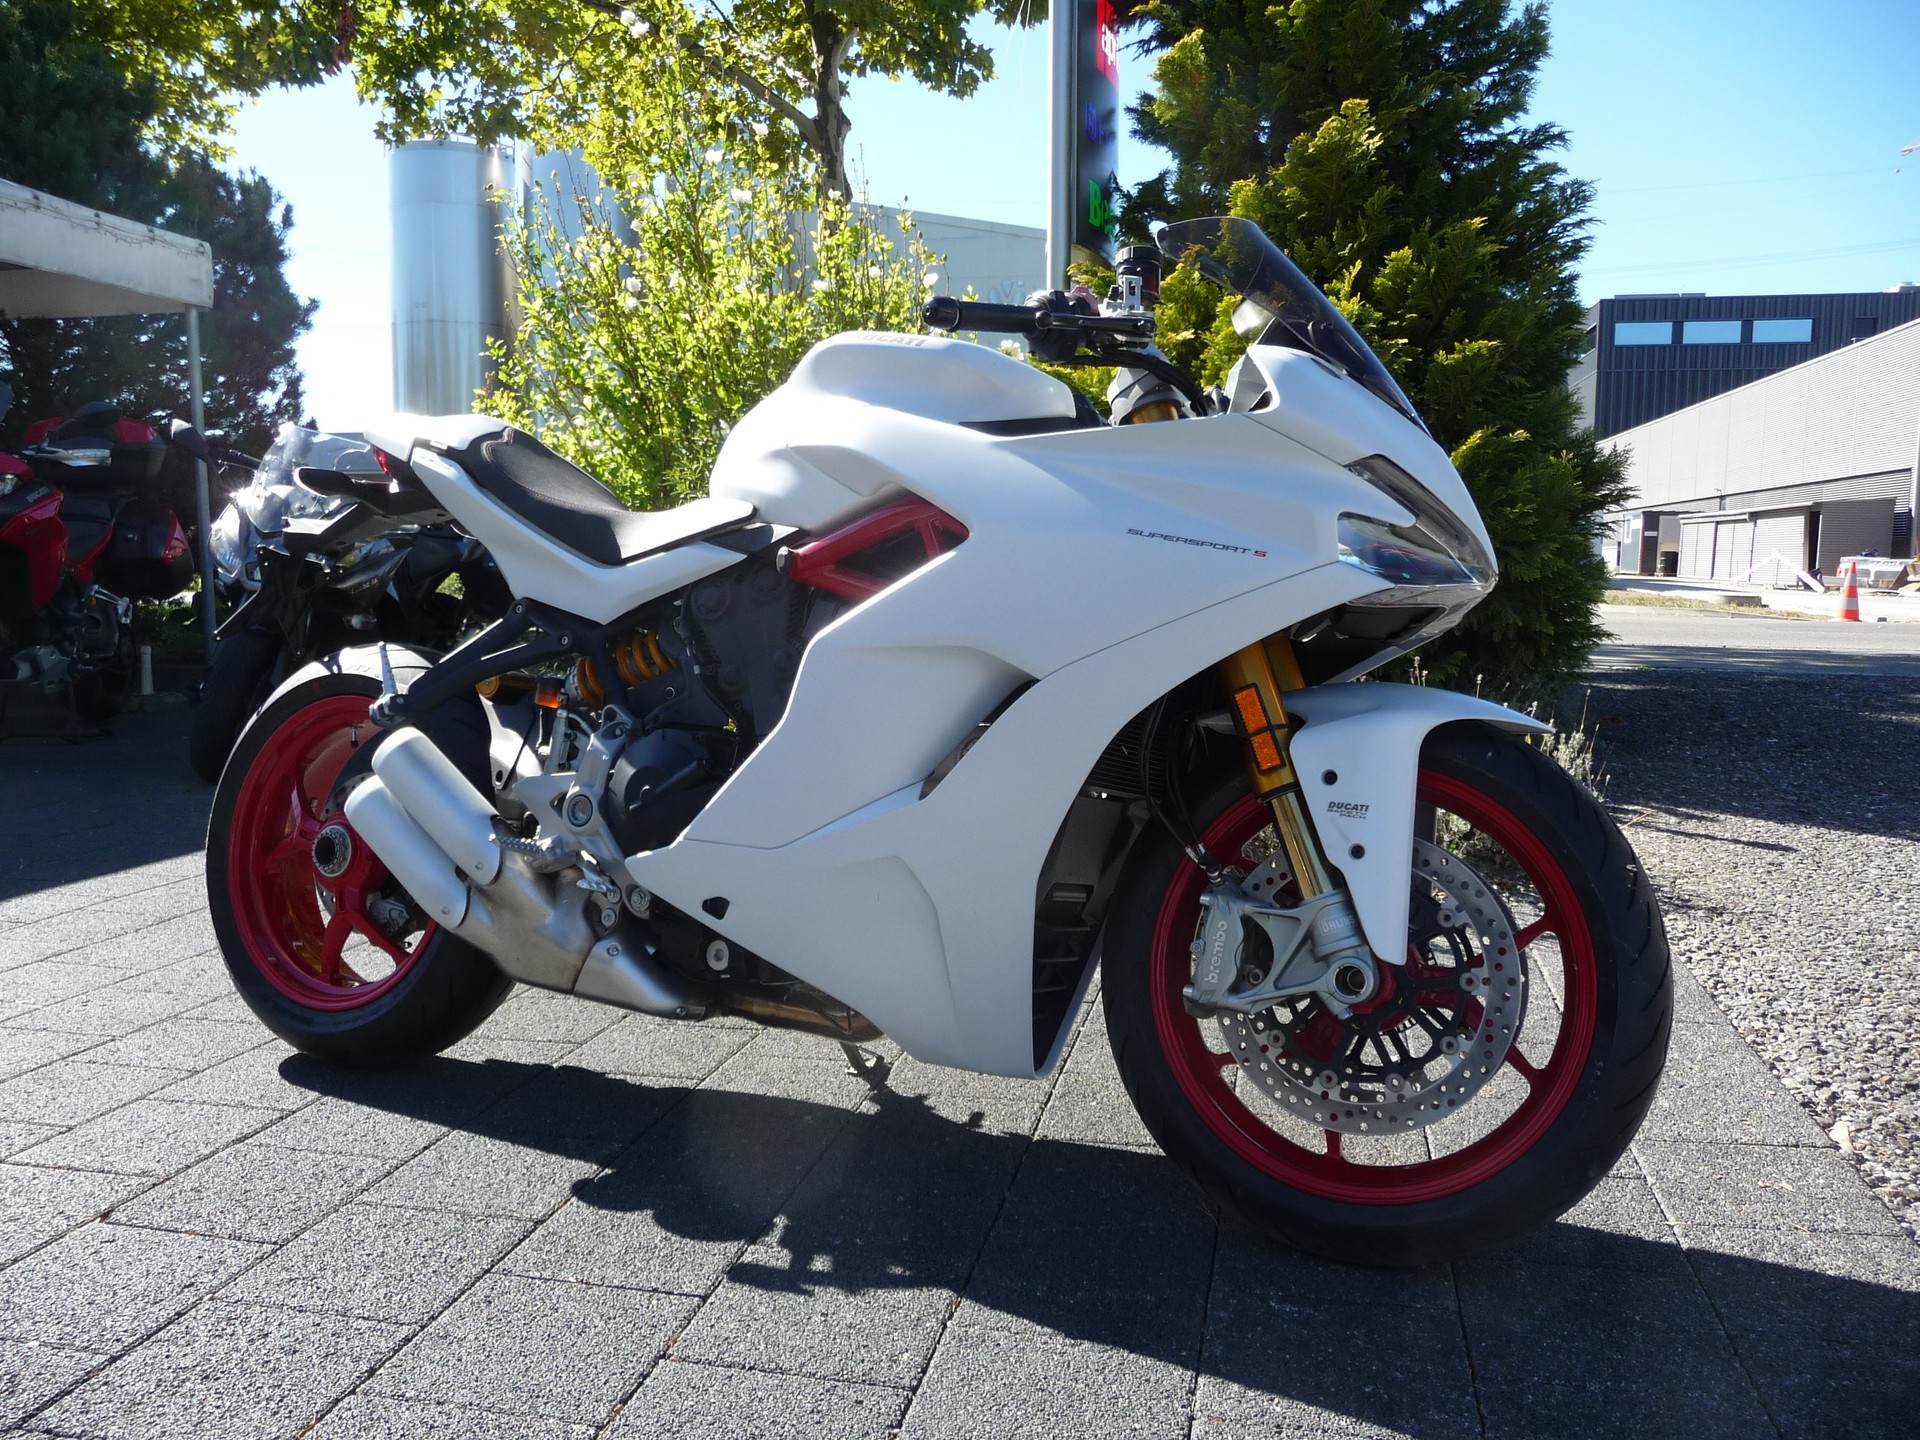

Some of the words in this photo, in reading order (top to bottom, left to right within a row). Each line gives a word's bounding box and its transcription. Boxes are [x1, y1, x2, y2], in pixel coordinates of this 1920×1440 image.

[1126, 528, 1251, 554] SUPERSPORT
[1253, 550, 1267, 558] S
[1328, 801, 1369, 812] DUCATI
[1204, 920, 1228, 984] brembo
